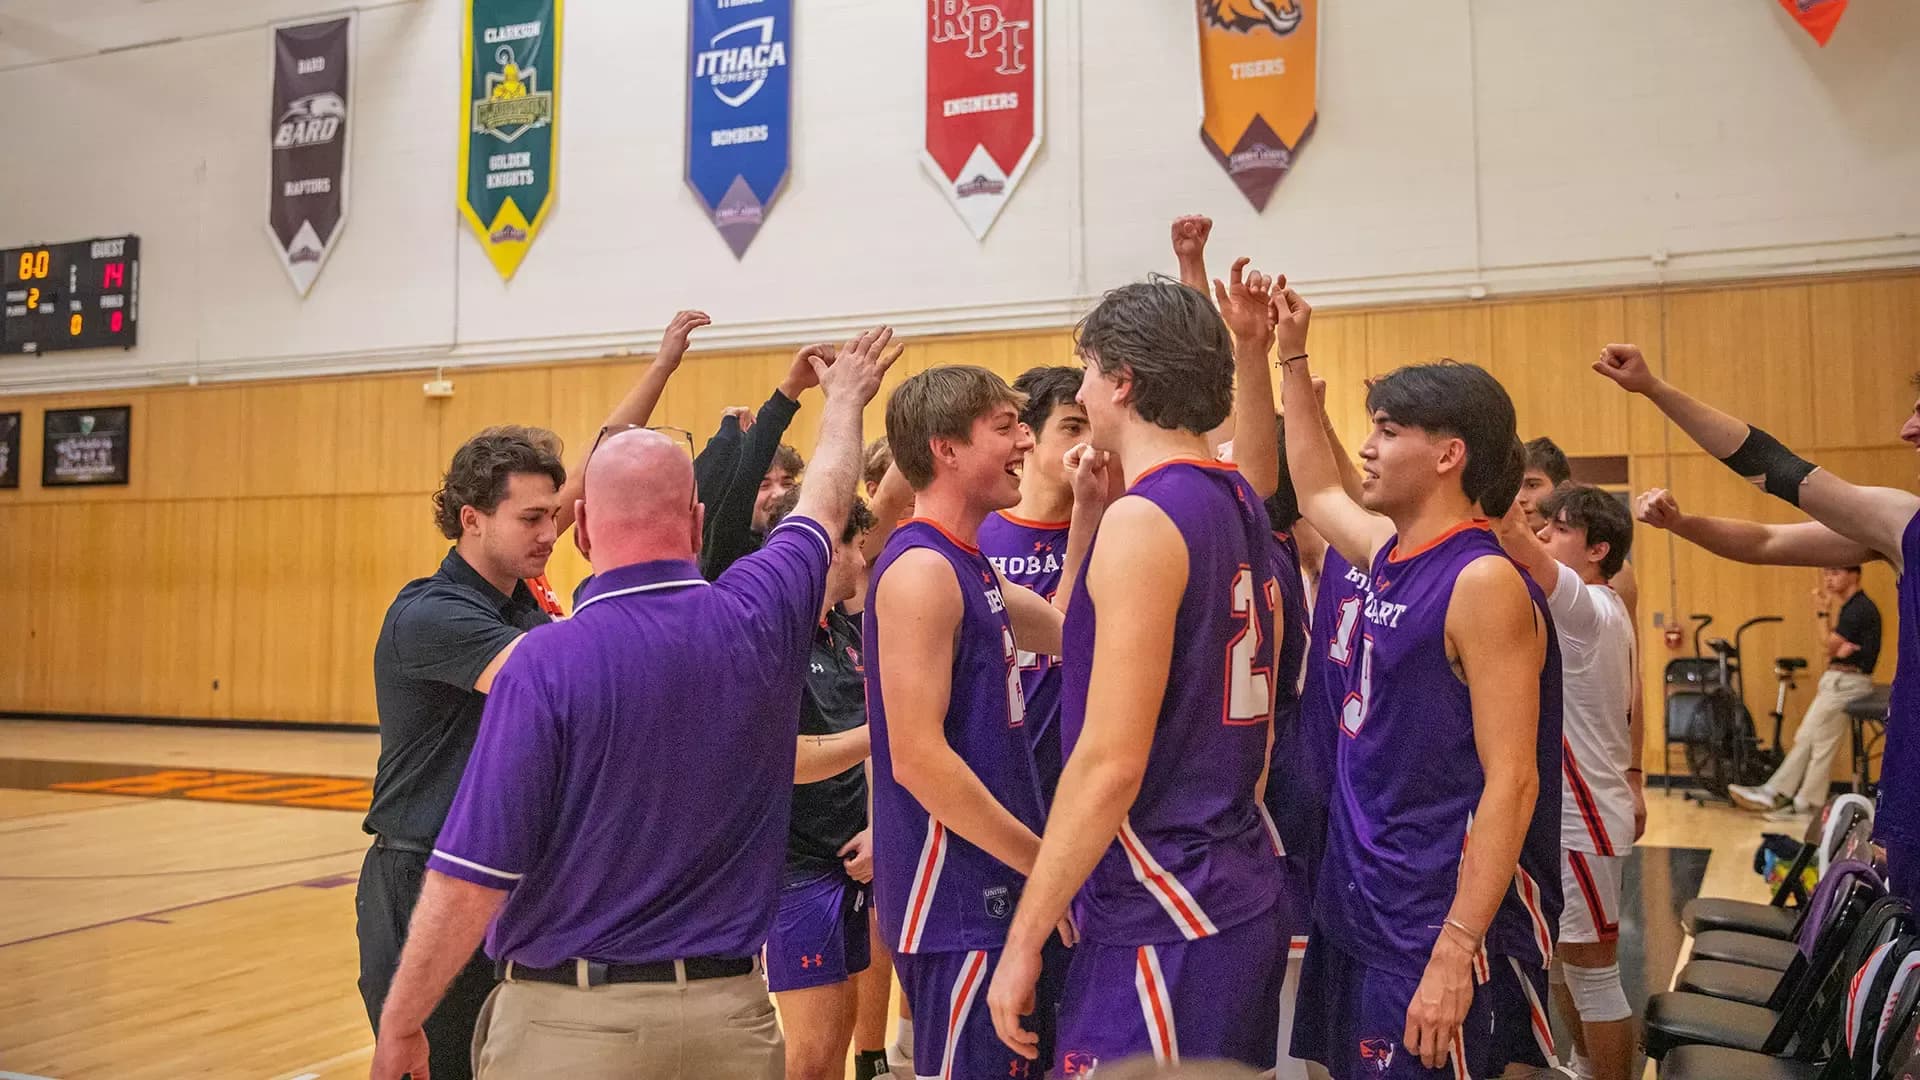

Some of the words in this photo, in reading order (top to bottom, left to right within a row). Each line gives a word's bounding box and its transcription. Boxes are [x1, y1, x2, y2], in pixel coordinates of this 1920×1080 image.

[484, 20, 541, 43] CLARKSON
[932, 0, 1029, 74] RPI
[696, 41, 786, 77] ITHACA
[1229, 57, 1286, 80] TIGERS
[711, 68, 768, 85] BOMBERS
[943, 92, 1018, 117] ENGINEERS
[274, 117, 339, 146] BARD
[711, 124, 769, 146] BOMBERS
[489, 152, 531, 171] GOLDEN
[486, 169, 534, 189] KNIGHTS
[91, 239, 125, 259] GUEST
[103, 262, 124, 289] 14
[27, 287, 40, 309] 2
[70, 314, 82, 336] 0
[988, 553, 1066, 576] HOBA
